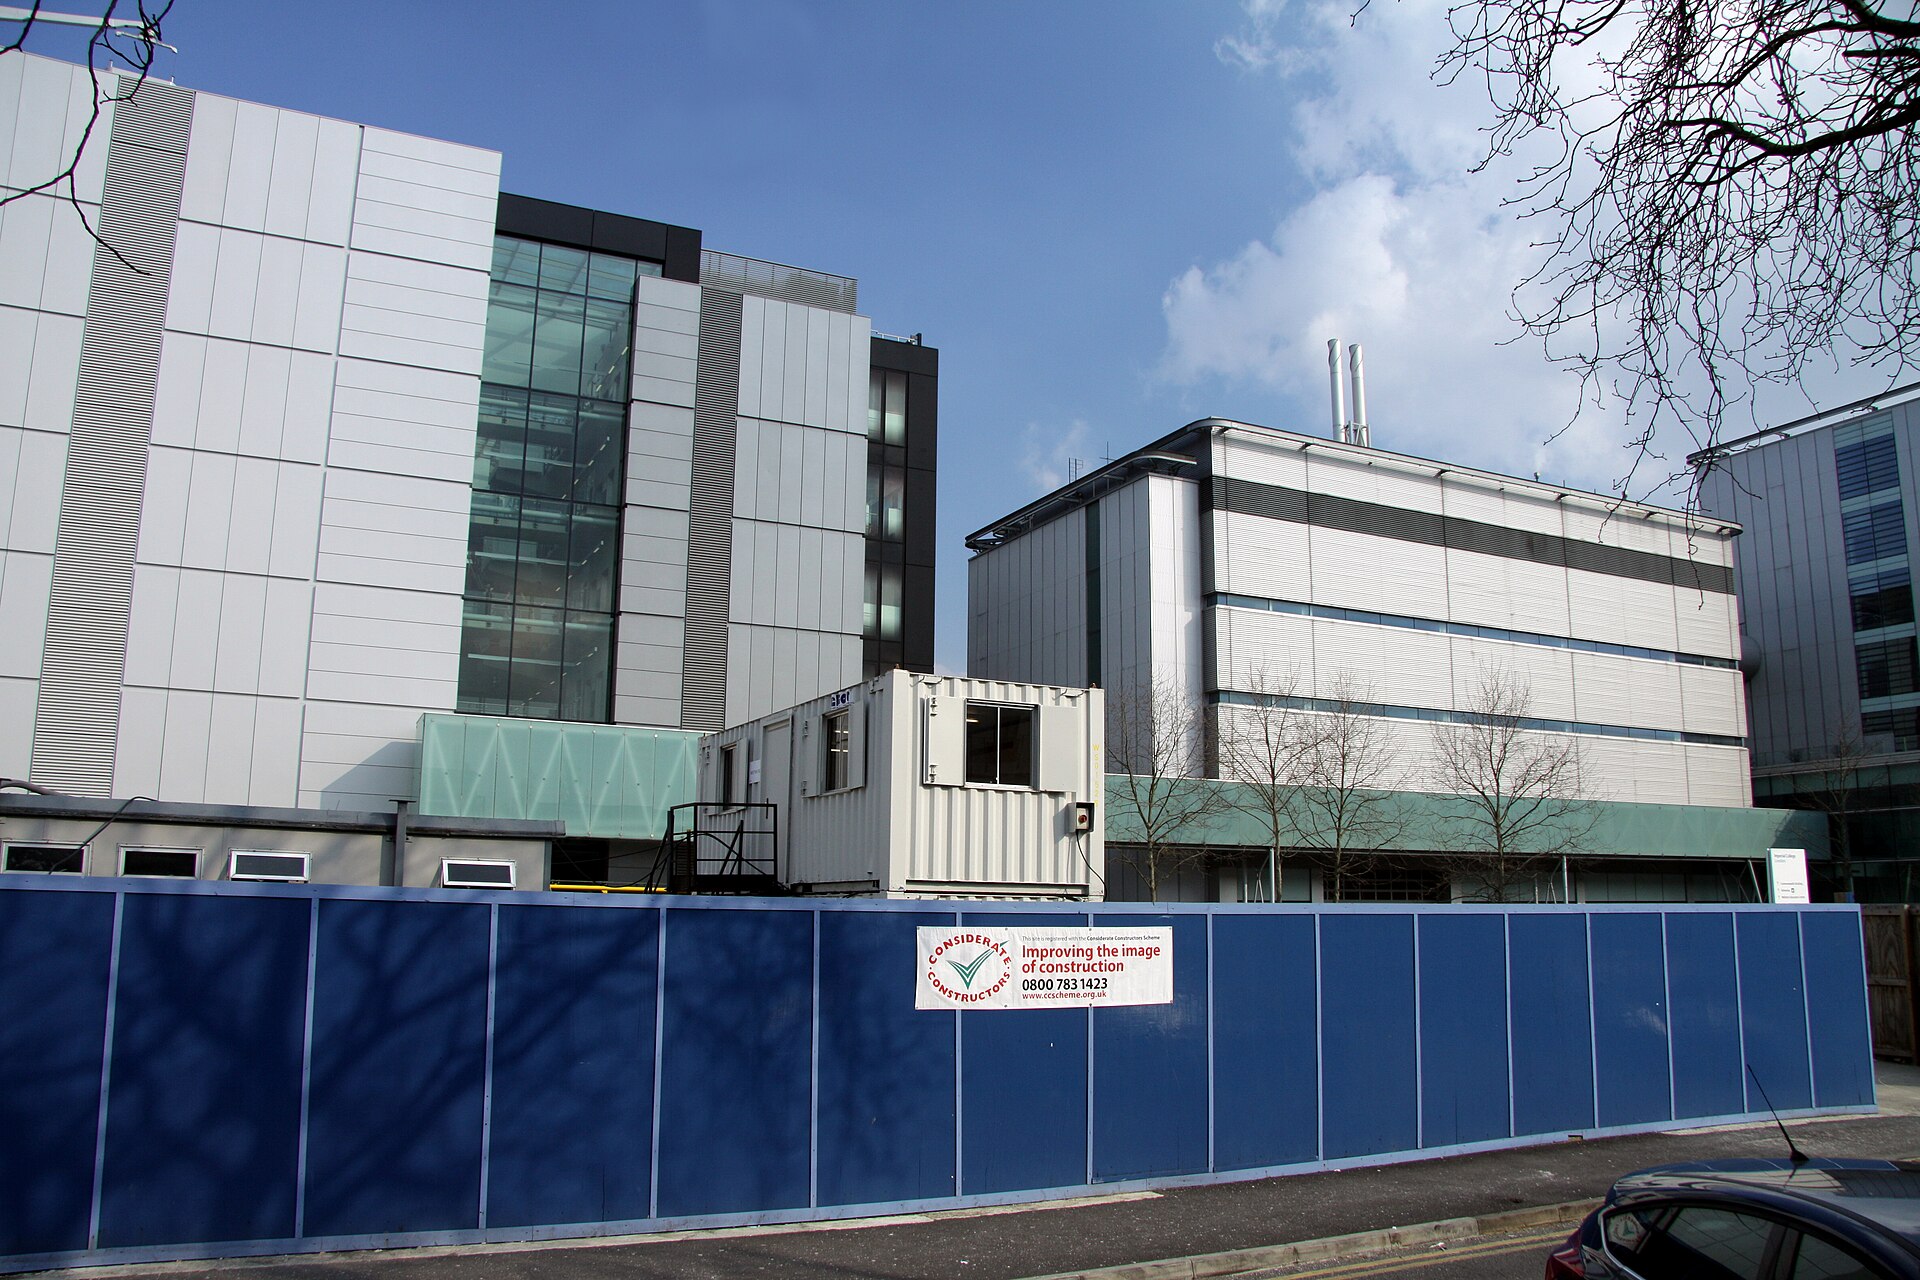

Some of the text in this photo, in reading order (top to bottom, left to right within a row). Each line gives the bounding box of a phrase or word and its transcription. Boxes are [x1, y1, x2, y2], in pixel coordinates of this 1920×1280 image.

[928, 933, 1012, 966] CONSIDERATE
[1022, 944, 1161, 961] Improving the image
[1022, 959, 1125, 974] of construction
[928, 971, 1010, 1002] CONSTRUCTORS
[1022, 977, 1108, 991] 0800 783 1423
[1022, 990, 1107, 1000] www.ccscheme.org.uk
